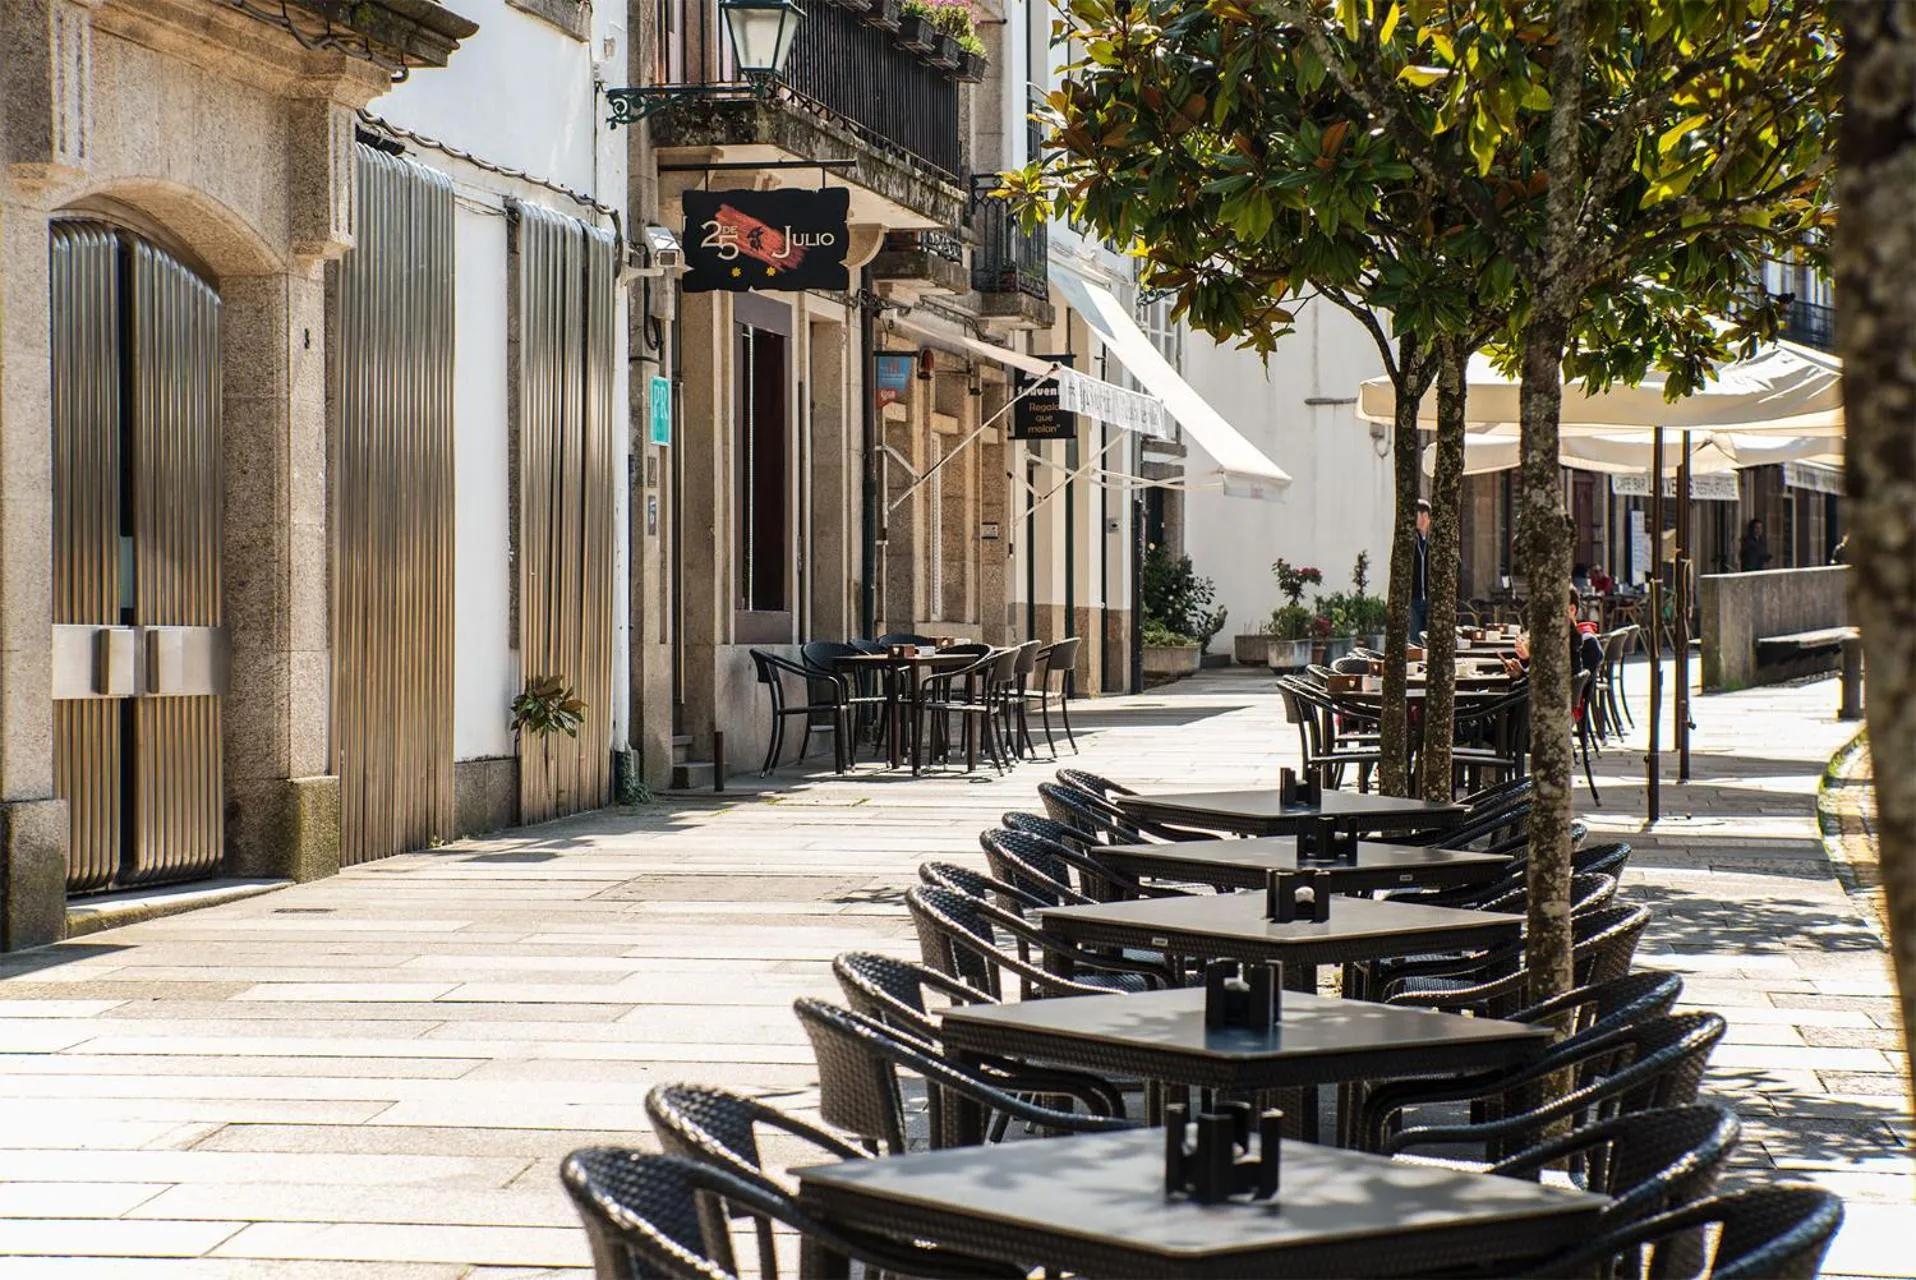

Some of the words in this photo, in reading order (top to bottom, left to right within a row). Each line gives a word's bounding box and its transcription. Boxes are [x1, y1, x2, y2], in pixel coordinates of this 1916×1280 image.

[700, 219, 740, 260] 25
[721, 225, 738, 234] DE
[770, 225, 835, 258] JULIO
[1017, 385, 1059, 396] Suven
[1035, 414, 1053, 423] que
